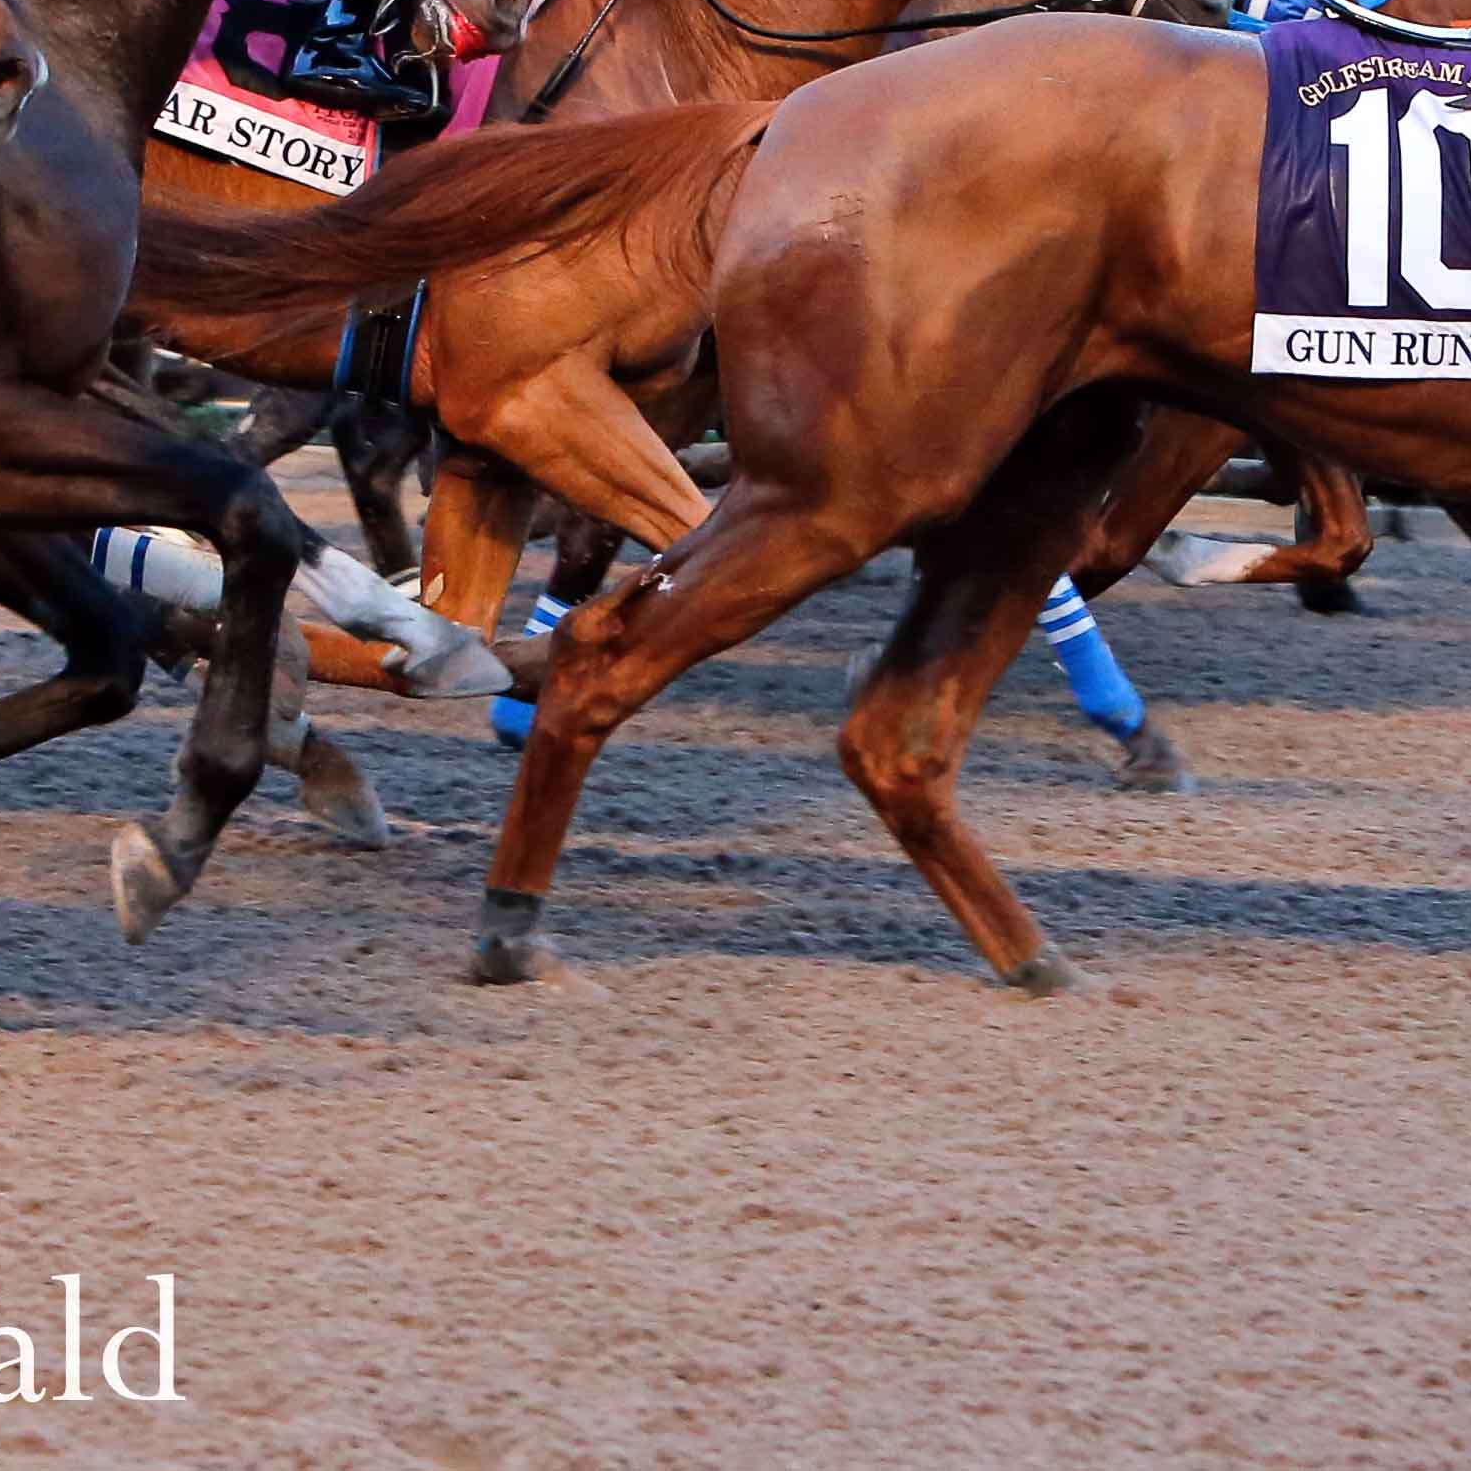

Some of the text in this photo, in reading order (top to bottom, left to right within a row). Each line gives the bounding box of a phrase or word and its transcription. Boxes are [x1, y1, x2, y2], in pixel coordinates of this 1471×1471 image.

[1297, 55, 1465, 106] GULFSTREAM
[227, 116, 365, 187] STORY
[1286, 329, 1376, 366] GUN
